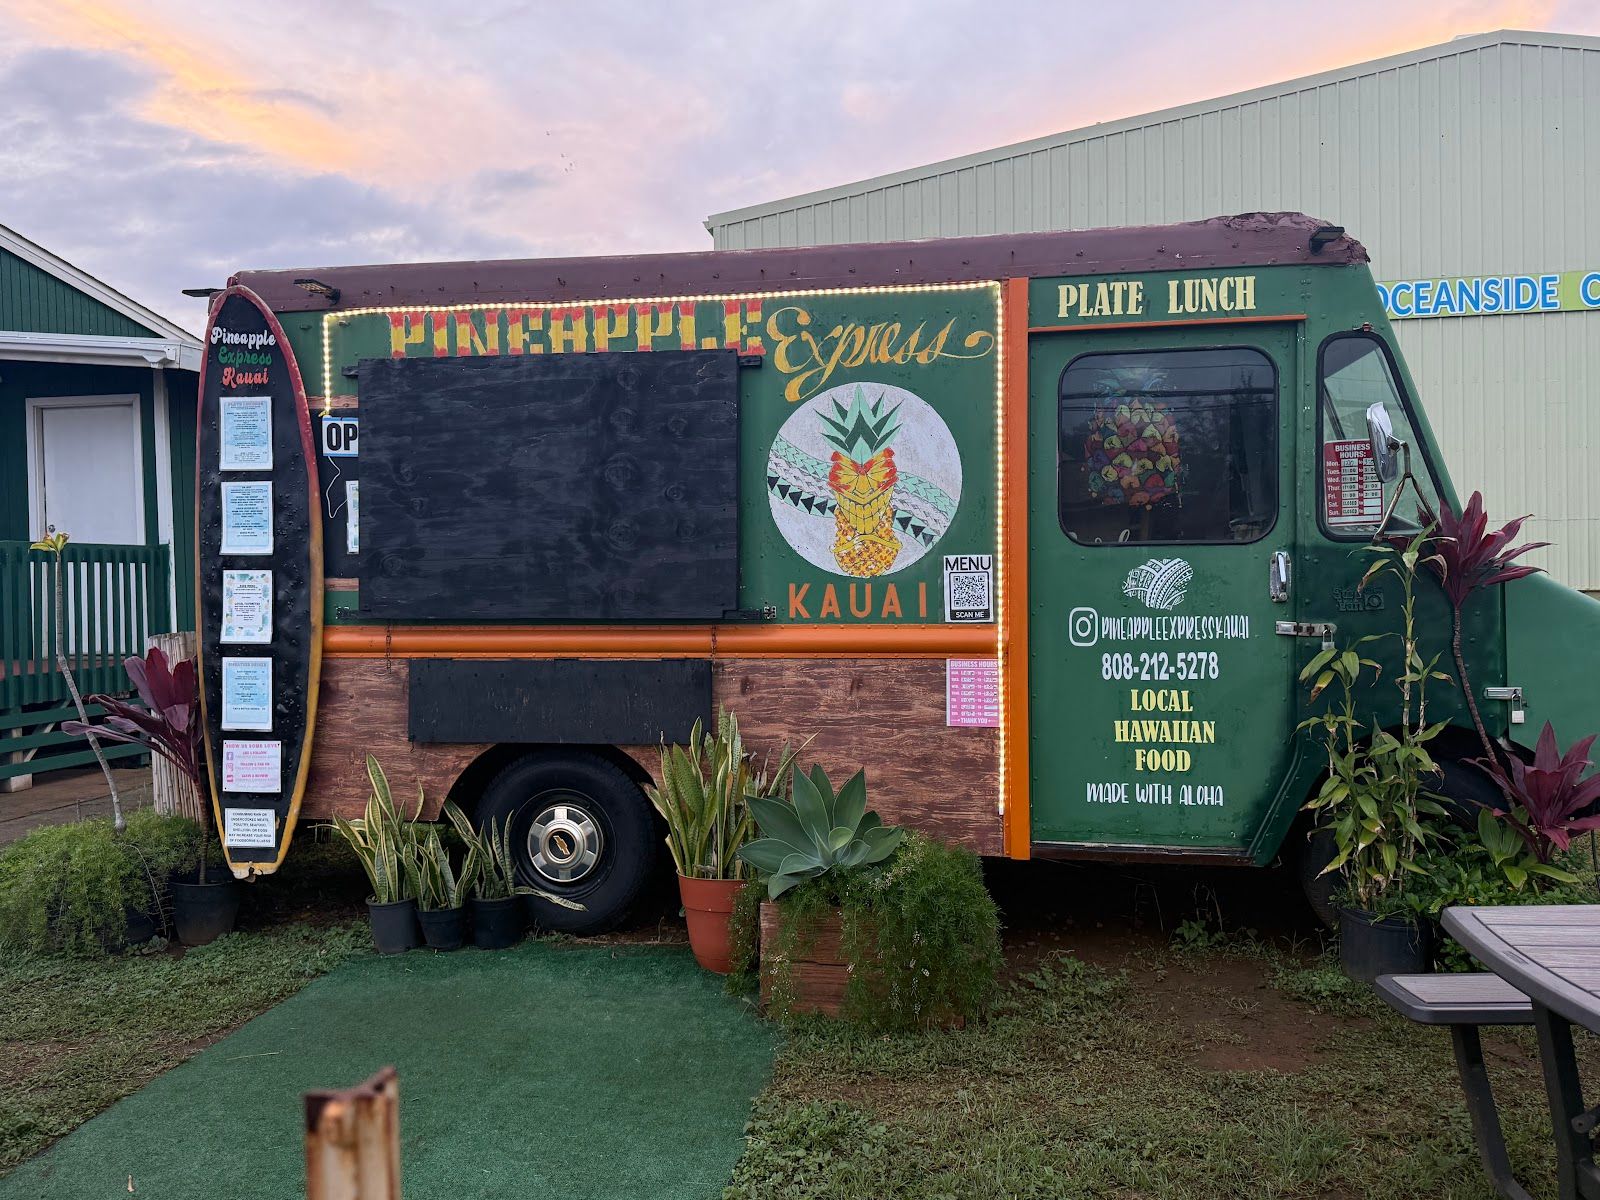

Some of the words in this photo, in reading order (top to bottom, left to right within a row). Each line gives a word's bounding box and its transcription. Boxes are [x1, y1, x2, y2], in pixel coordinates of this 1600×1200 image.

[1058, 281, 1144, 318] PLATE
[1167, 275, 1256, 314] LUNCH
[210, 326, 276, 350] Pineapple
[217, 346, 272, 367] Express
[387, 300, 766, 358] PINEAPPLE
[766, 306, 994, 402] Express
[222, 367, 269, 389] Kauai
[1335, 444, 1370, 452] BUSINESS
[945, 557, 991, 571] MENU
[788, 582, 927, 618] KAUAI
[1101, 615, 1249, 641] PINEAPPLEEXPRESSKAUAI
[1102, 651, 1219, 680] 808-212-5278
[1131, 689, 1193, 712] LOCAL
[1114, 720, 1215, 743] HAWAIIAN
[1135, 749, 1191, 772] FOOD
[1086, 783, 1129, 804] MADE
[1135, 783, 1172, 805] WITH
[1179, 785, 1224, 806] ALOHA
